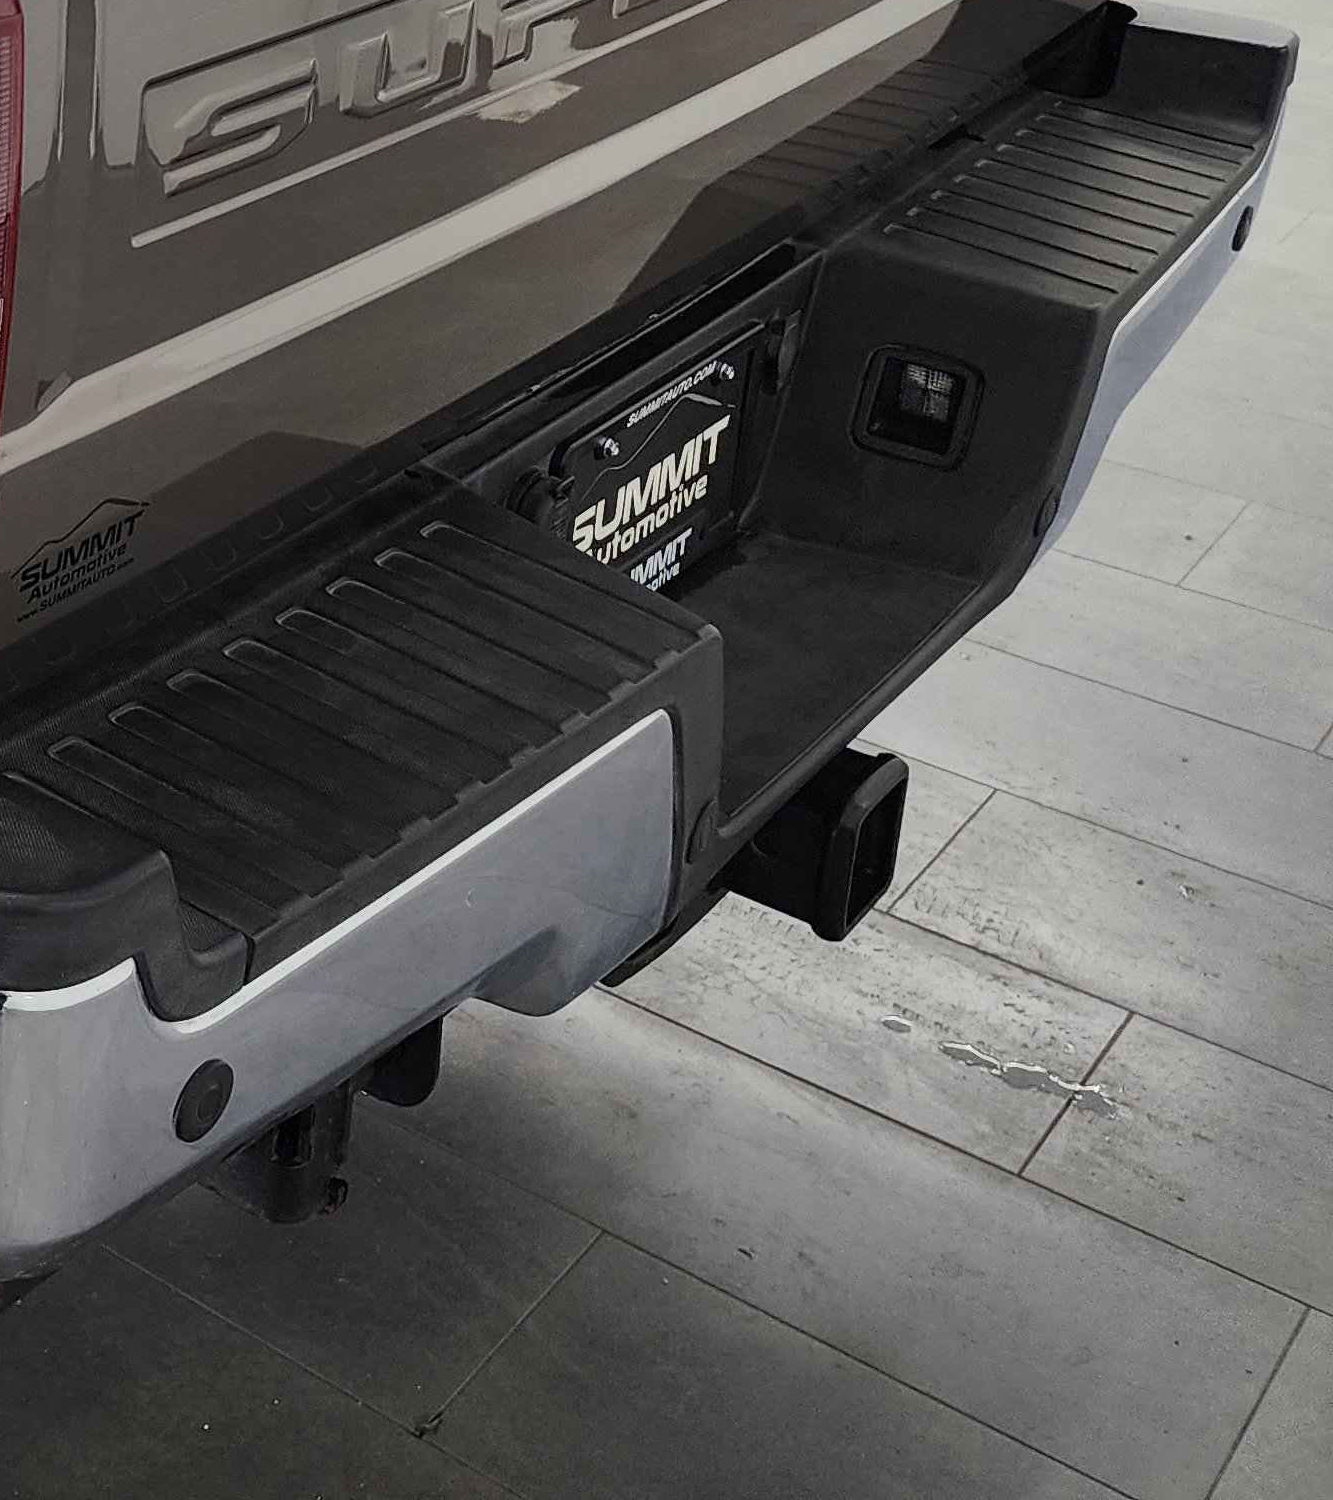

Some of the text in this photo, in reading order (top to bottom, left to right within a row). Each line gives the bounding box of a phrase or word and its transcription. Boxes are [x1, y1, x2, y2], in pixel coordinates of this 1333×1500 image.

[627, 361, 718, 428] SUMMITAUTO.COM
[572, 414, 731, 553] SUMMIT
[585, 475, 708, 565] utomotive
[20, 509, 144, 593] SUMMIT
[27, 543, 127, 604] Automotive
[630, 526, 693, 586] MMIT
